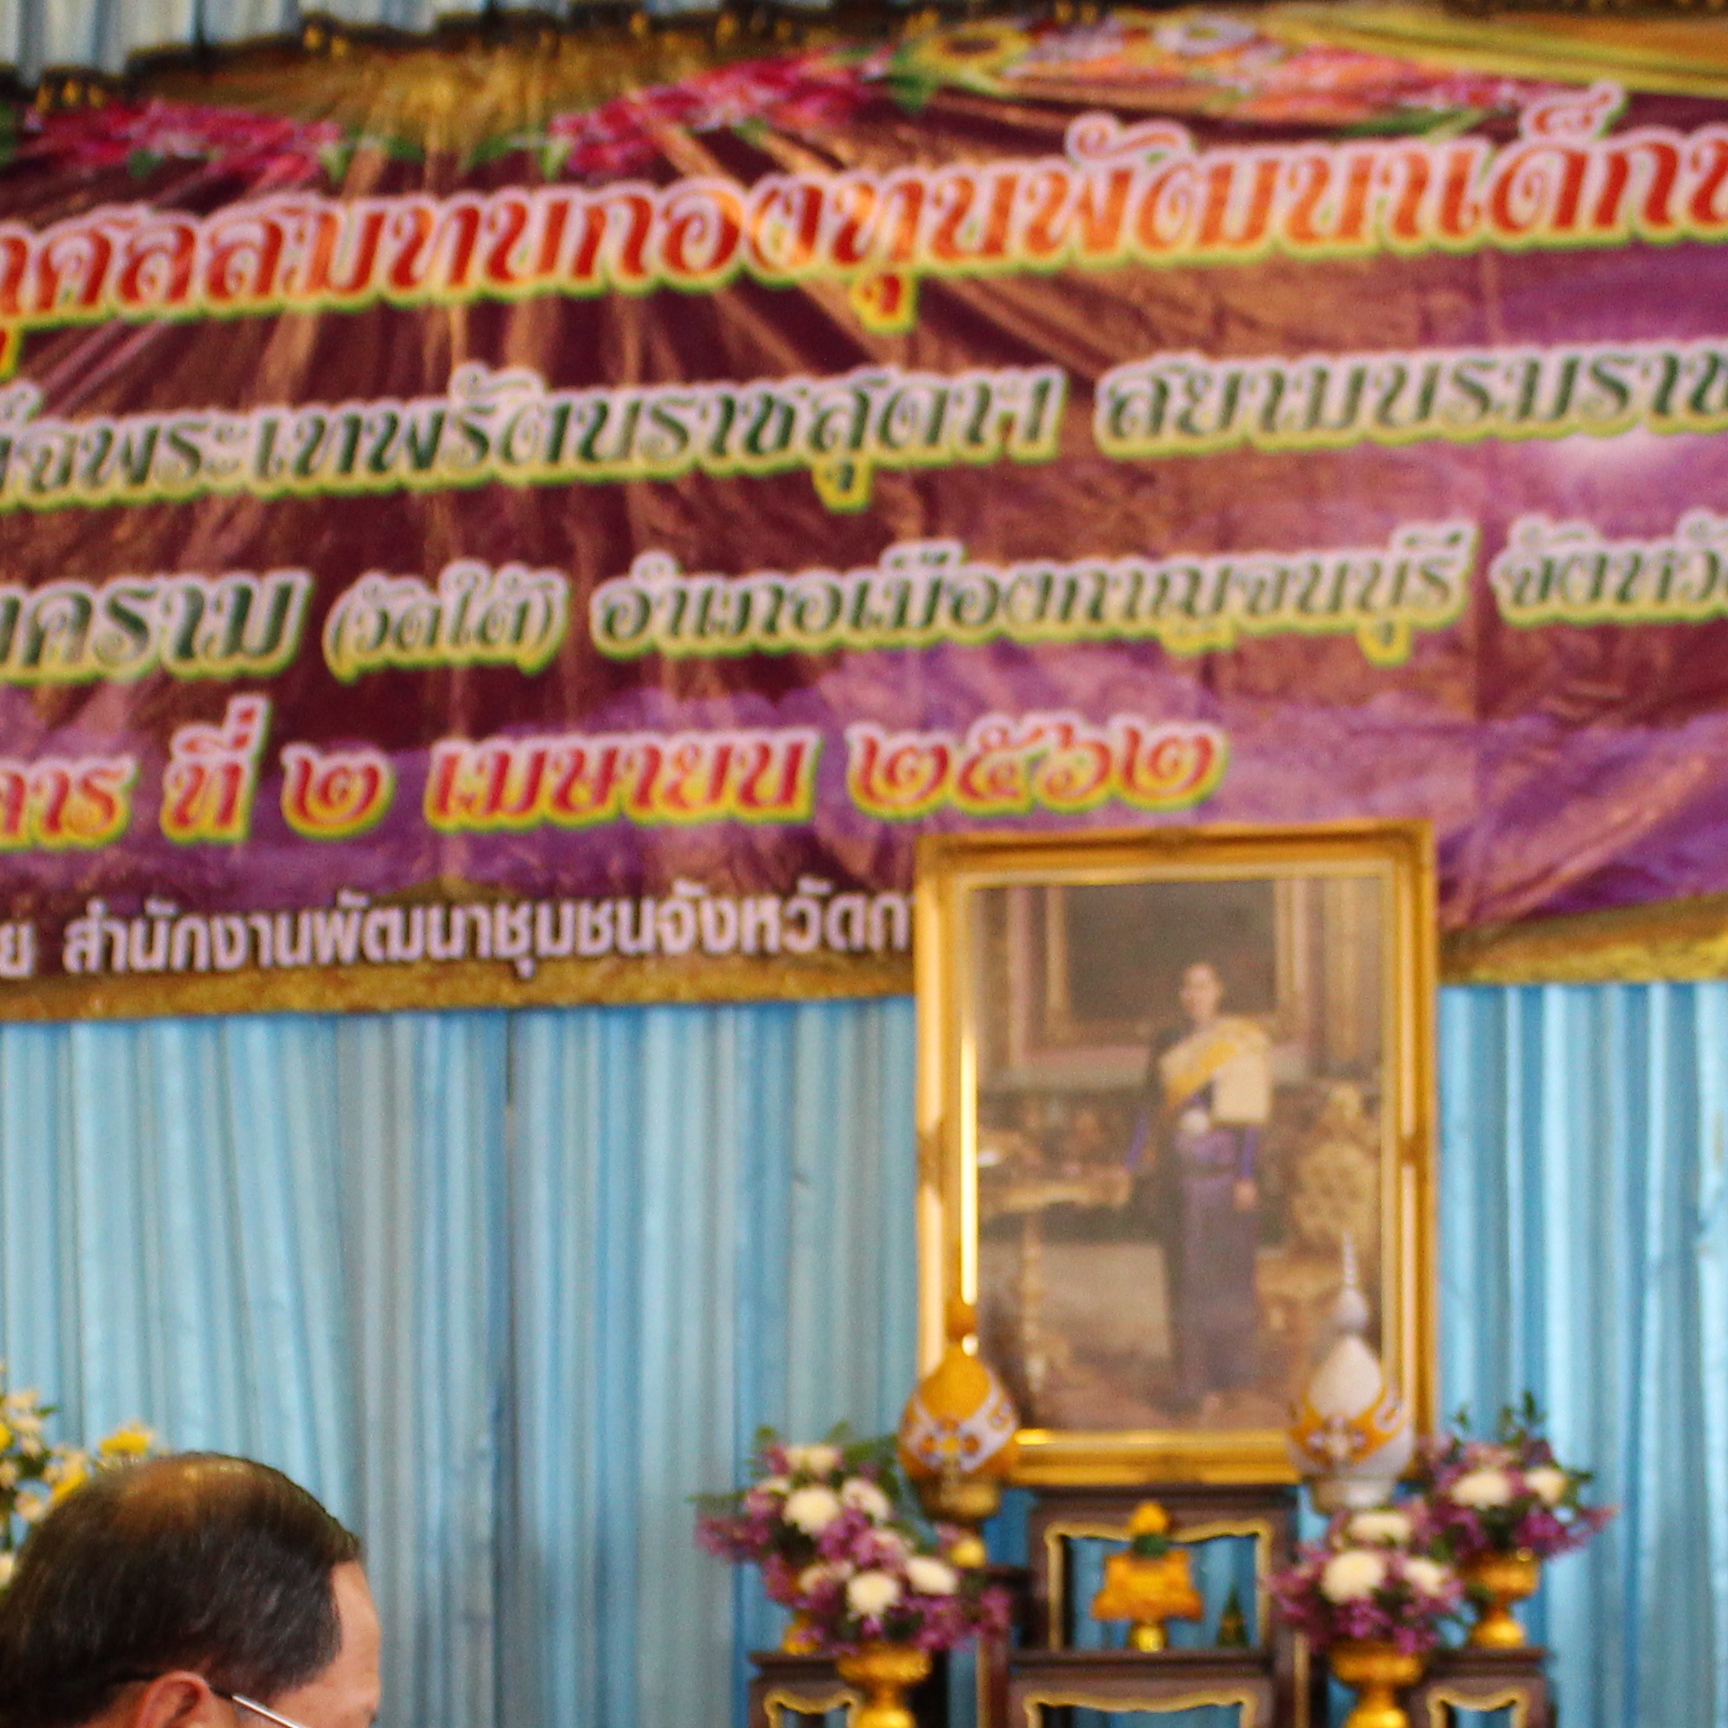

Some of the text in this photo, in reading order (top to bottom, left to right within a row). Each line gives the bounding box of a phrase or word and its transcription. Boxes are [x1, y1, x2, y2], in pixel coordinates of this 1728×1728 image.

[324, 560, 568, 683] (วัดใต้)
[590, 521, 1478, 666] อำเภอเมืองกาญจนบุรี
[161, 693, 269, 843] ที่
[281, 742, 394, 838] ๒
[424, 726, 820, 834] เมษายน
[844, 706, 1228, 820] ๒๕๖๒
[63, 875, 915, 976] สำนักงานพัฒนาชุมชนจังหวัดก
